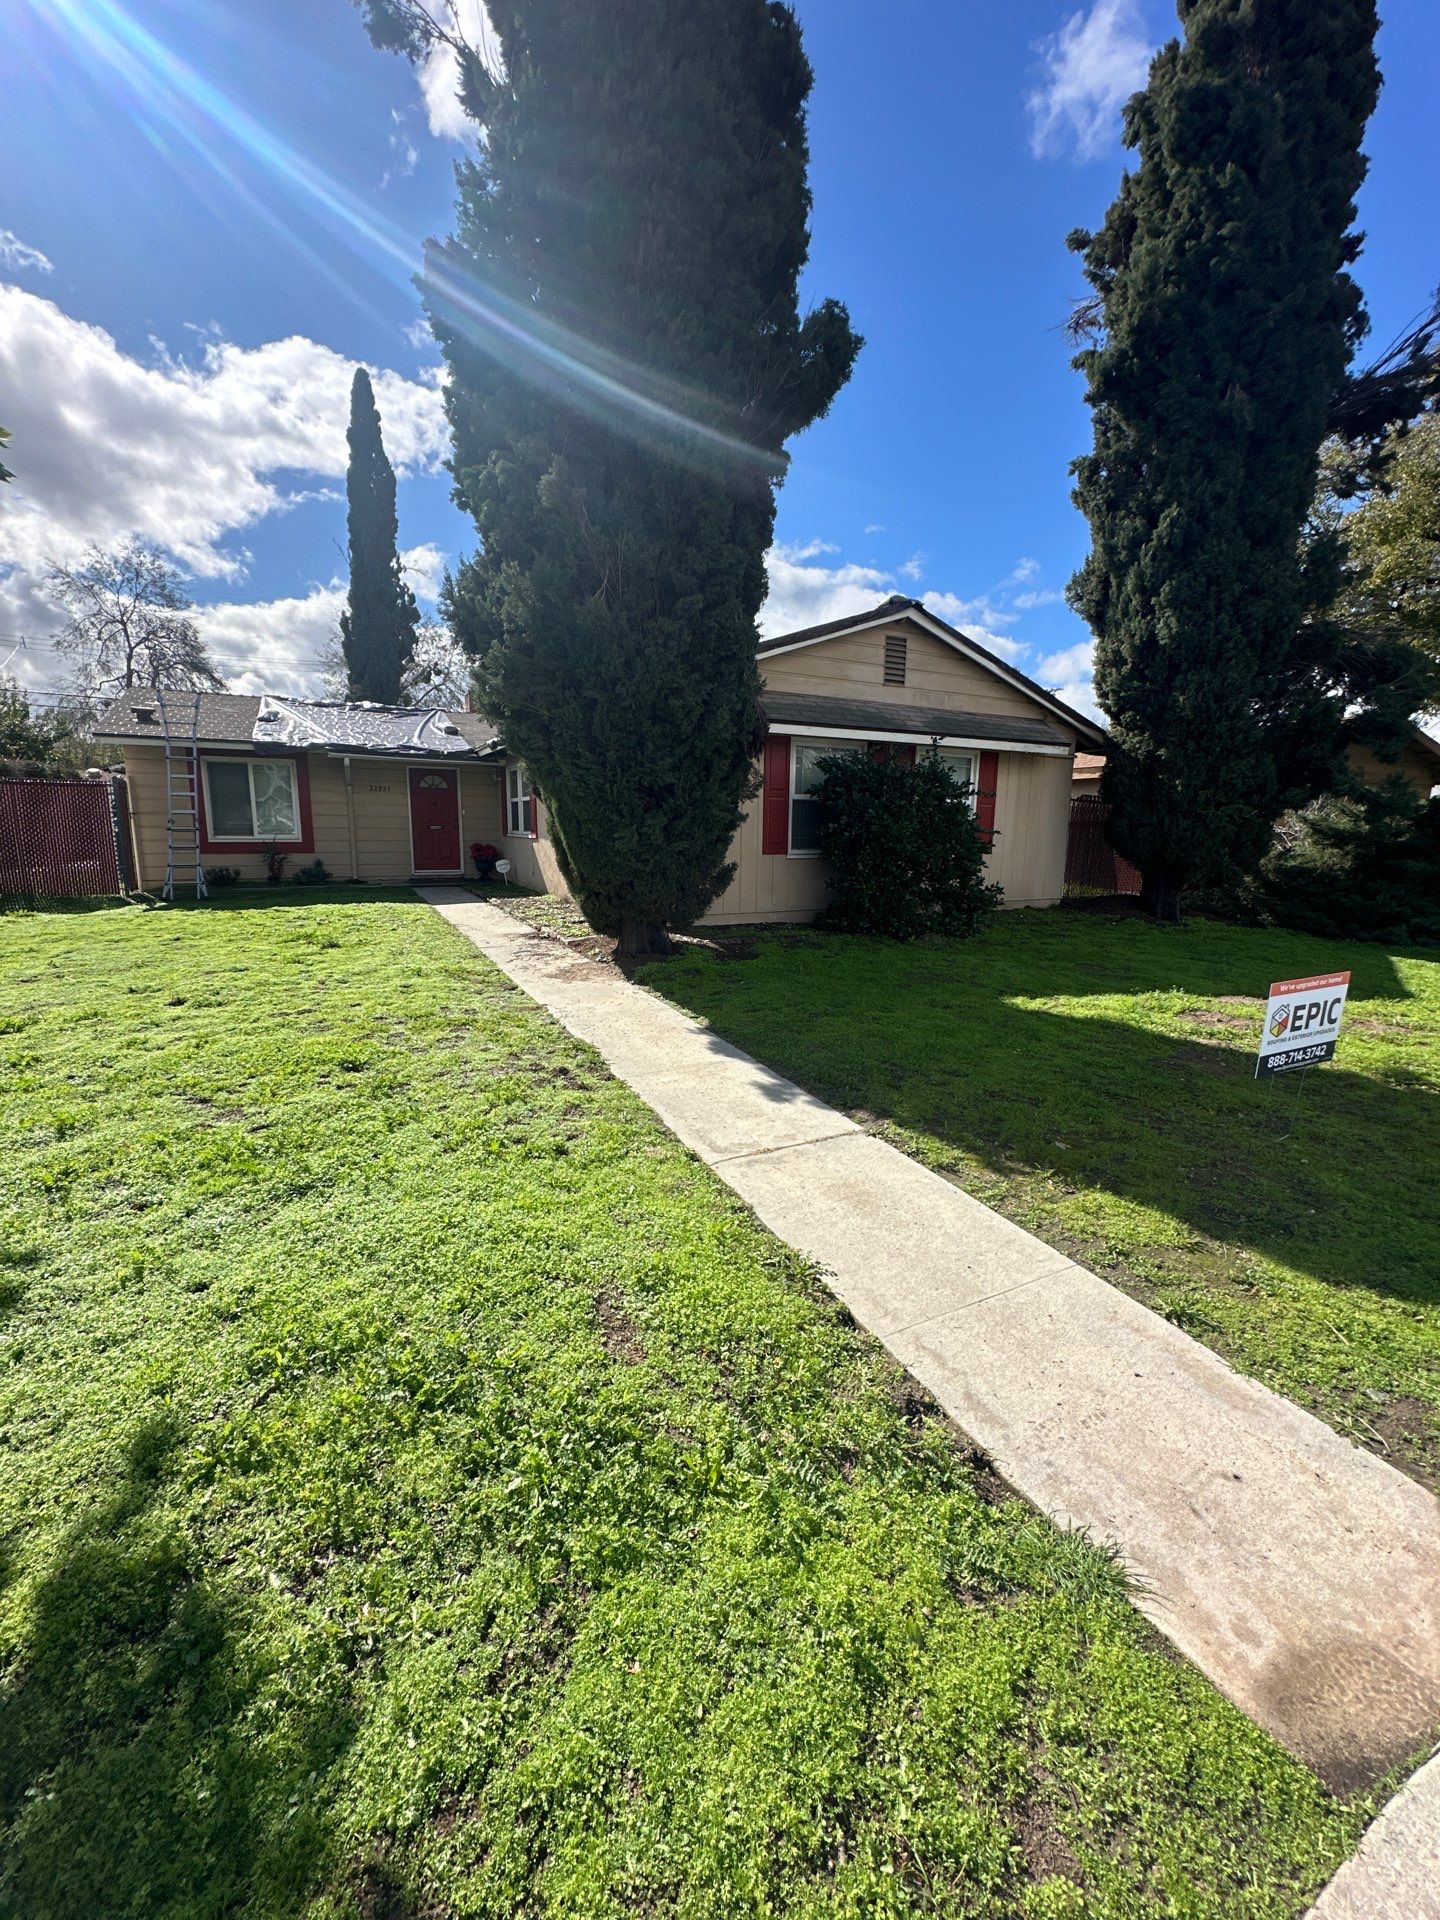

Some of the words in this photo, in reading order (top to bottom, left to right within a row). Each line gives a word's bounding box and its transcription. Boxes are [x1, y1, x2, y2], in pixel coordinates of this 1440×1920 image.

[1296, 980, 1319, 990] upgraded
[1290, 998, 1341, 1032] EPIC
[1267, 1037, 1287, 1046] ROOFING
[1291, 1032, 1313, 1041] EXTERIOR
[1267, 1045, 1327, 1068] 888-714-3742
